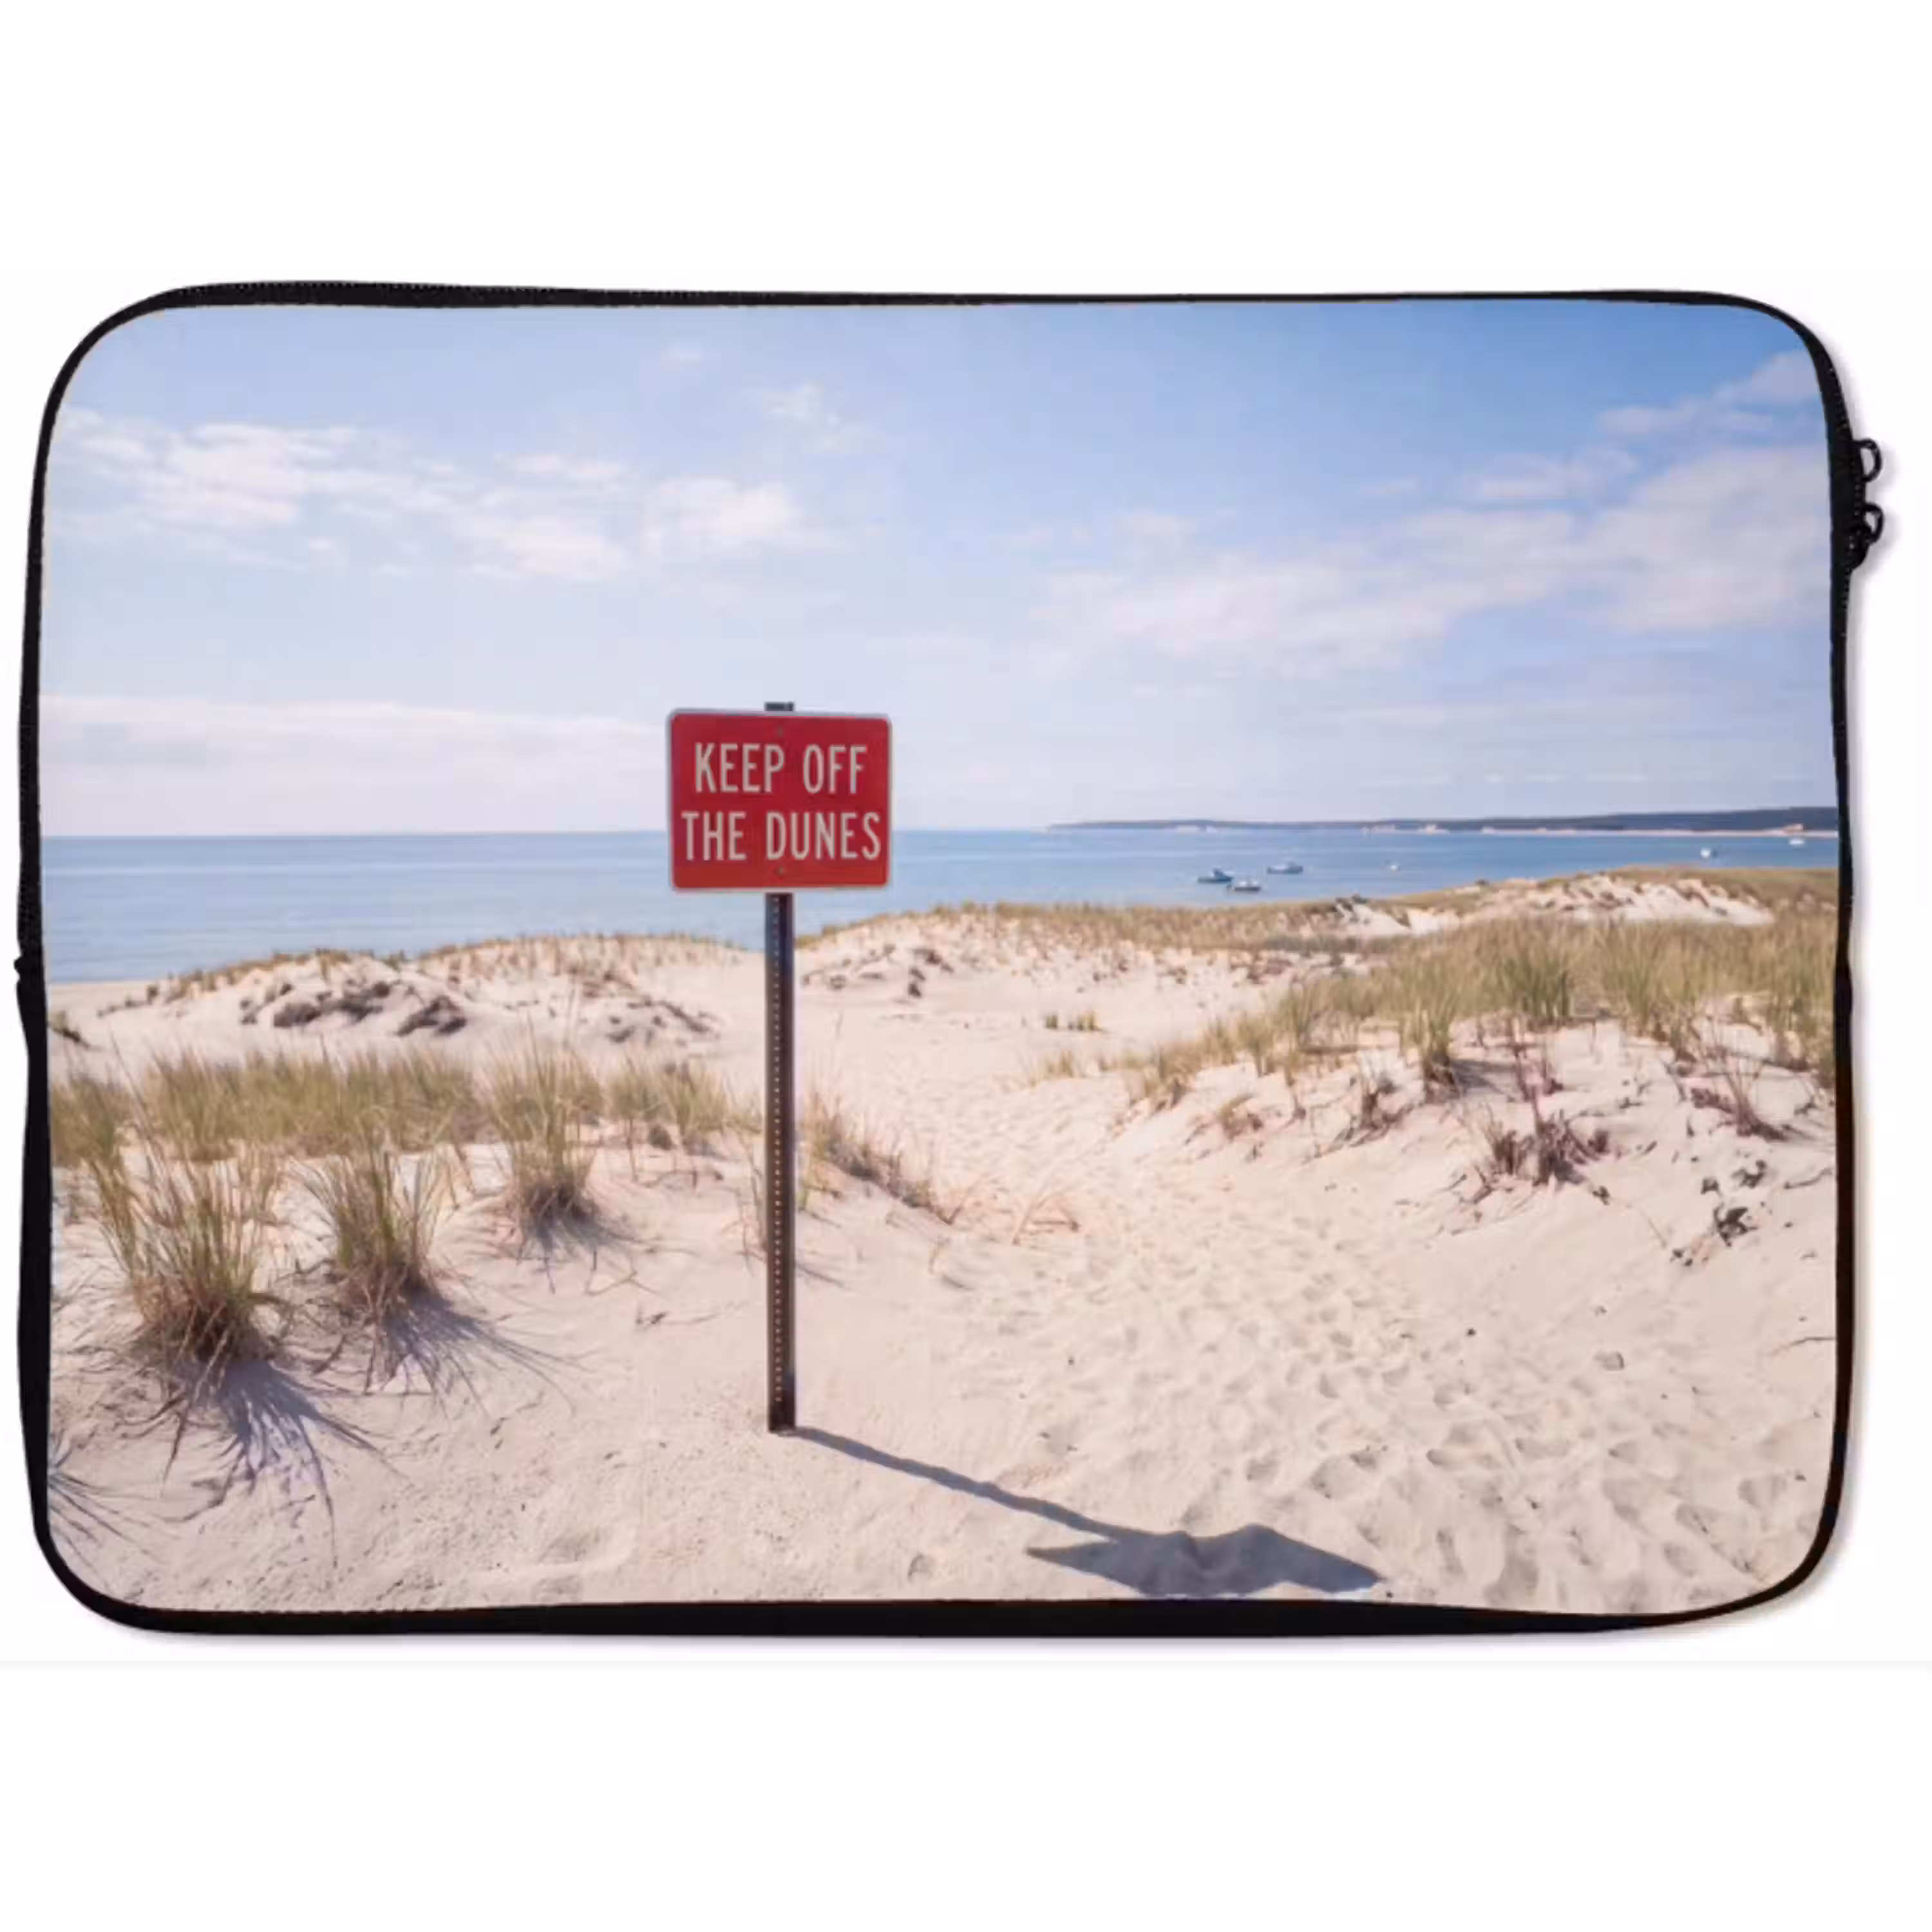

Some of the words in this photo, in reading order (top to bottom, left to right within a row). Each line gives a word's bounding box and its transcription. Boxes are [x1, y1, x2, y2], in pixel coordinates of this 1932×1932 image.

[695, 743, 785, 793] KEEP
[802, 744, 867, 794] OFF
[681, 811, 747, 861] THE
[766, 811, 881, 860] DUNES
